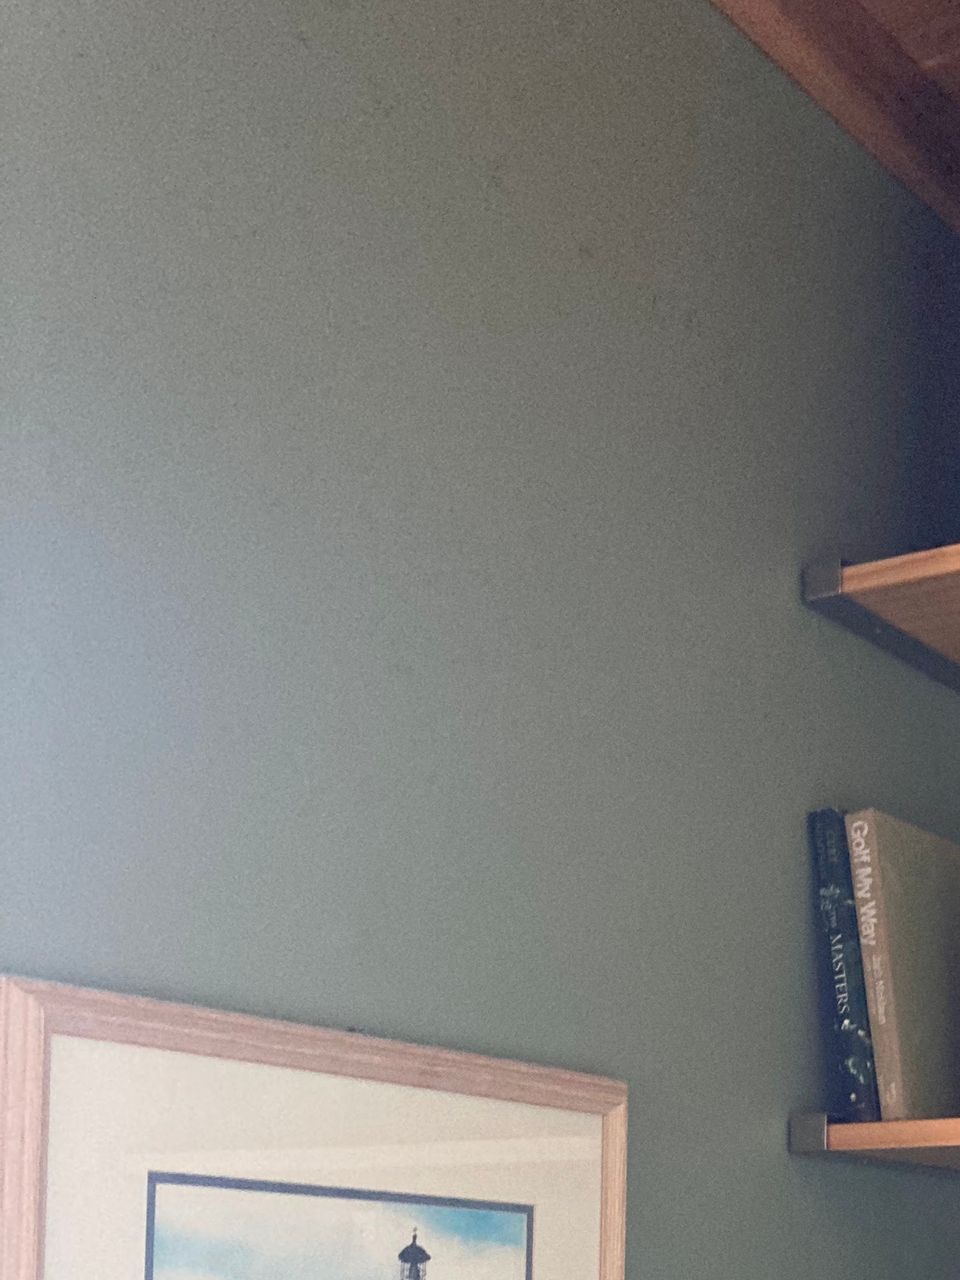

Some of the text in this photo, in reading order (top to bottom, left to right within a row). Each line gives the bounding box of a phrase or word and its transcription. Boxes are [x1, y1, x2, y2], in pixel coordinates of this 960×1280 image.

[851, 820, 870, 863] Golf
[855, 867, 872, 898] My
[860, 902, 878, 945] Way
[830, 934, 850, 1014] MASTERS
